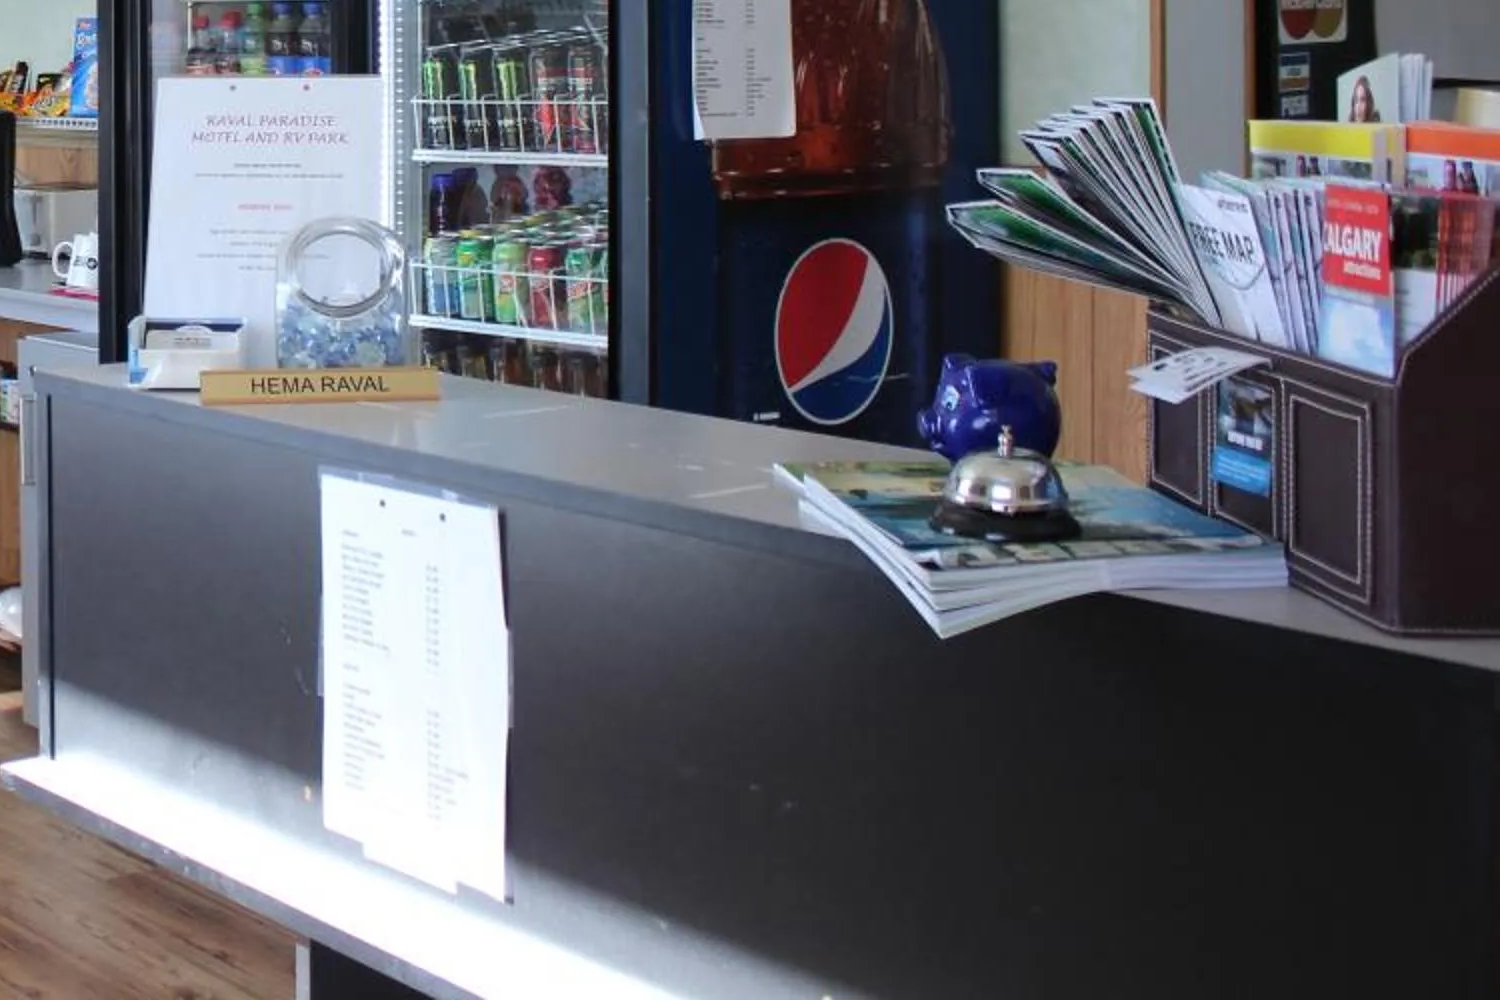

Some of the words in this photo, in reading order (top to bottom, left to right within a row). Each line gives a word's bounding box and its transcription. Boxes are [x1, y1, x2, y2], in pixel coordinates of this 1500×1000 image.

[258, 114, 338, 127] PARADISE
[192, 131, 242, 144] MOTEL
[244, 131, 279, 145] AND
[282, 131, 305, 145] RV
[308, 131, 349, 145] PARK
[1188, 220, 1225, 258] FREE
[1222, 231, 1254, 264] MAP
[250, 376, 316, 395] HEMA
[320, 375, 390, 393] RAVAL
